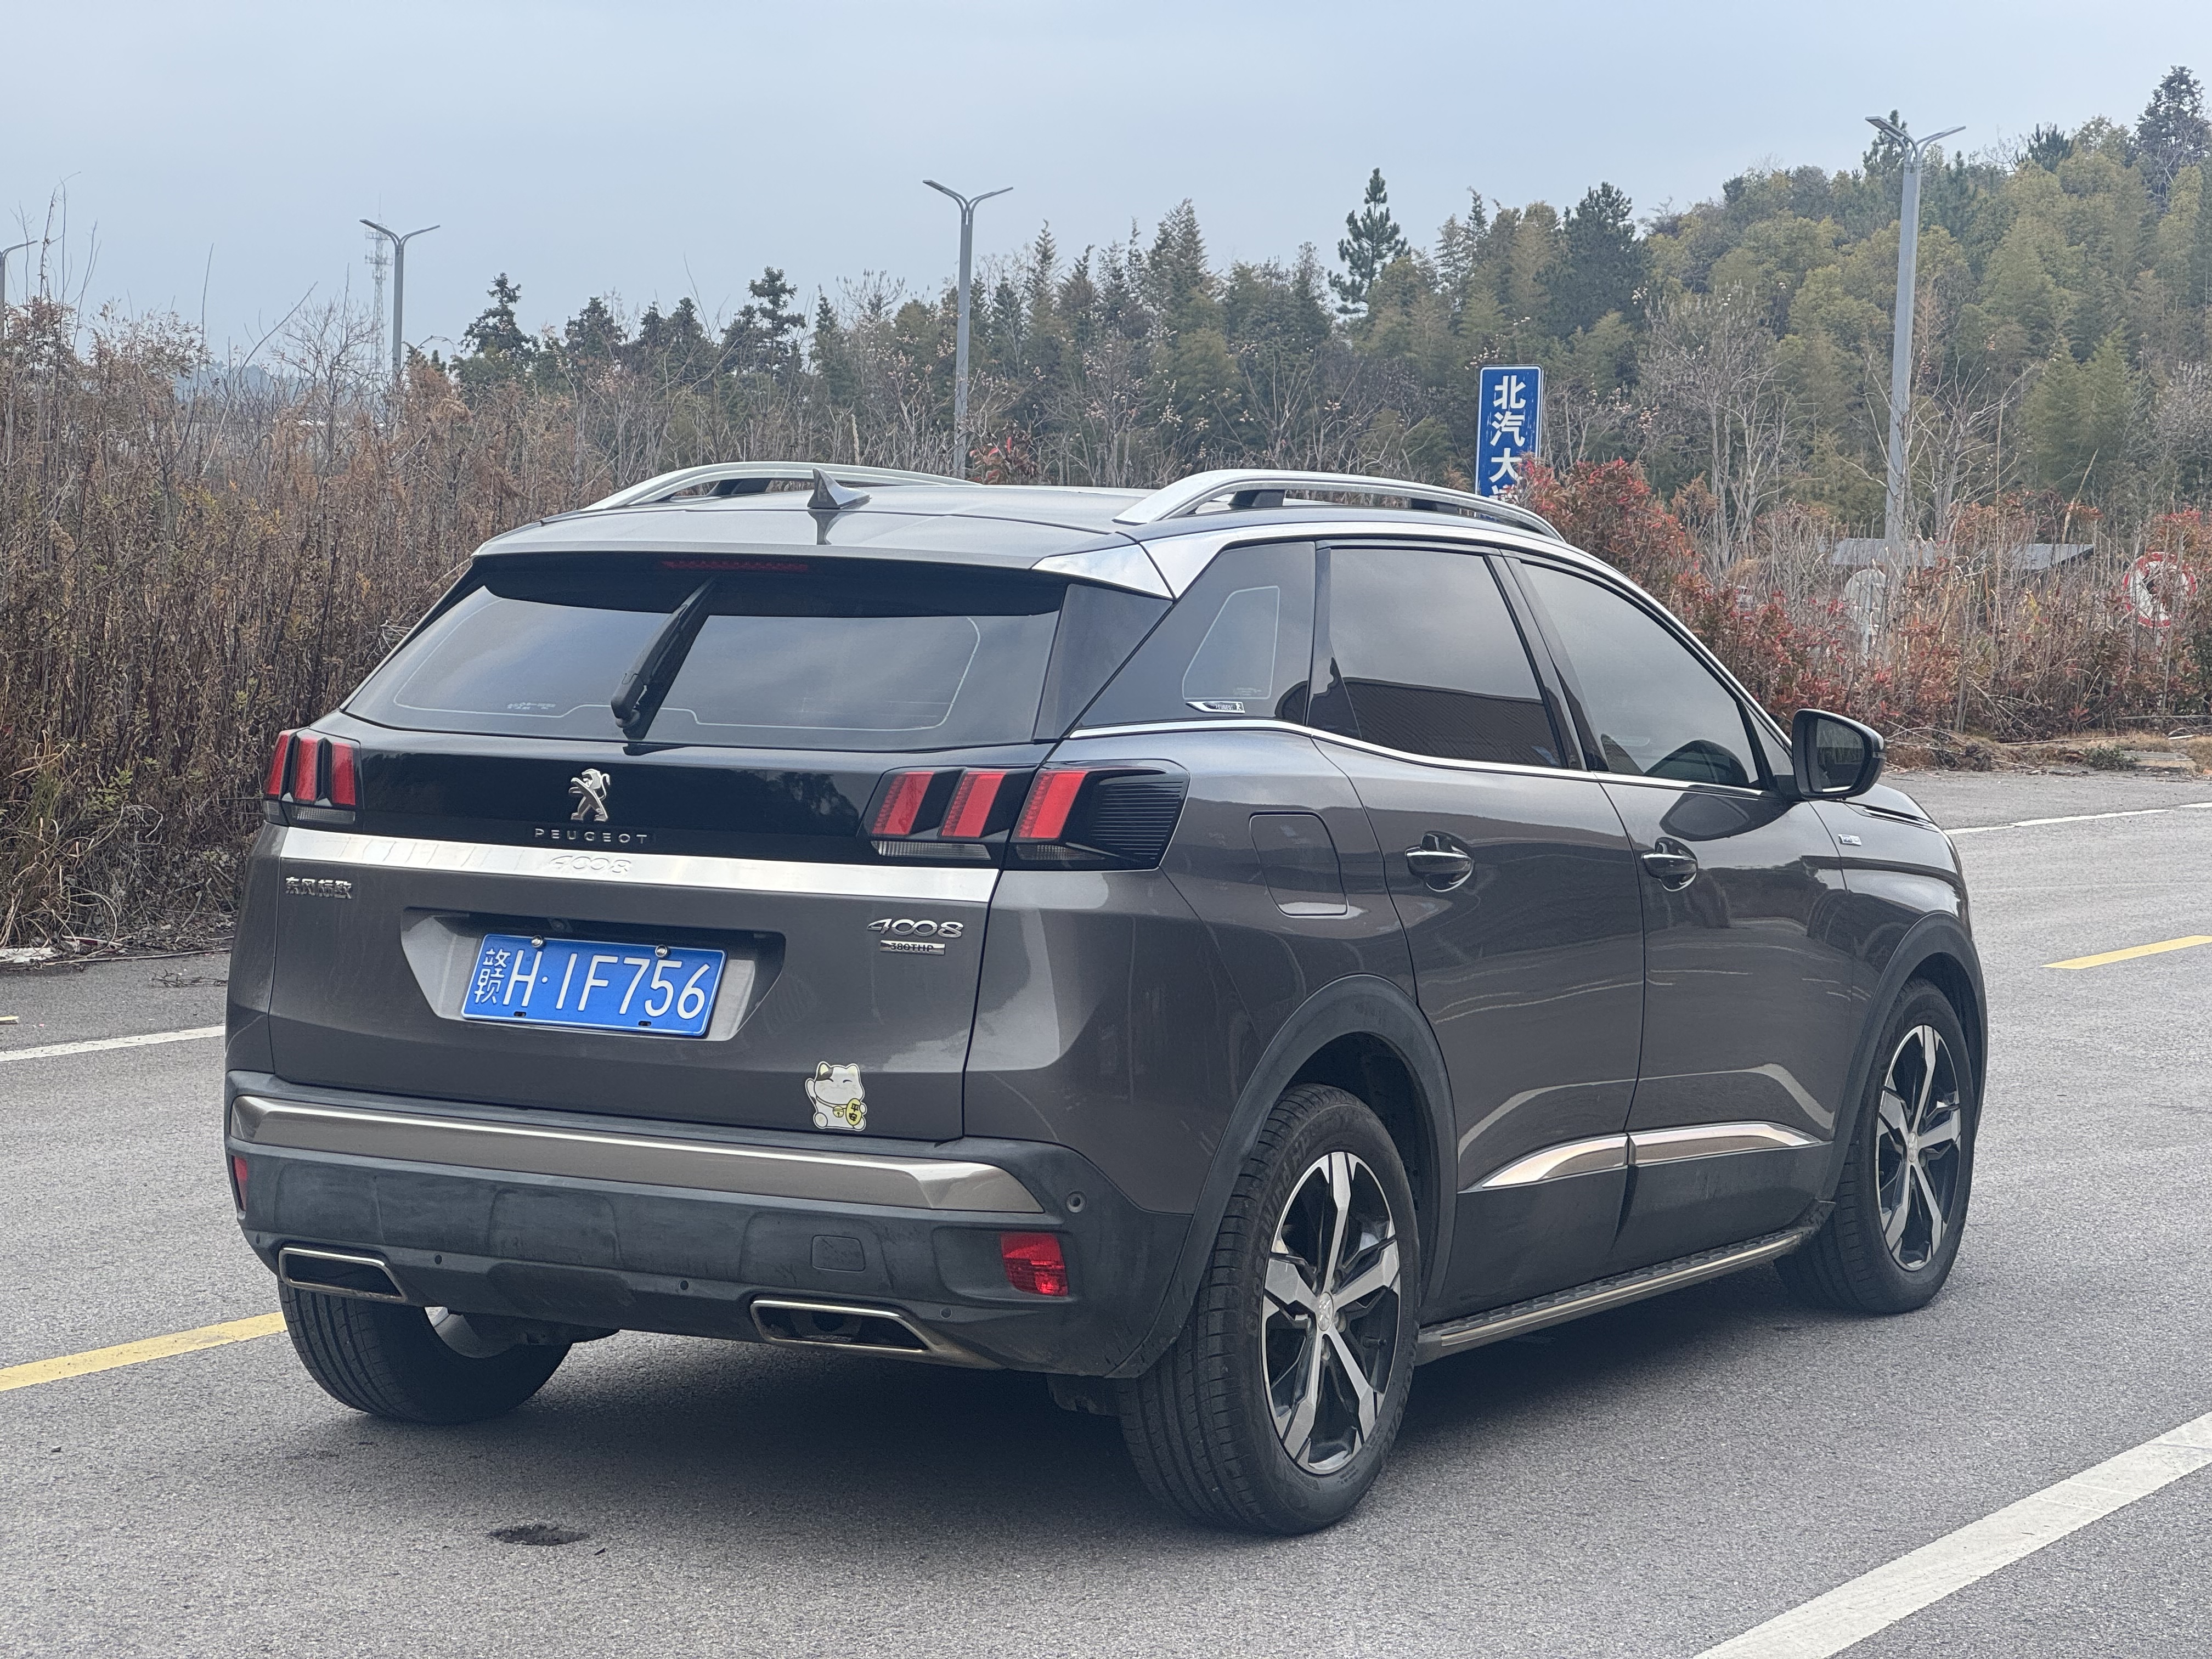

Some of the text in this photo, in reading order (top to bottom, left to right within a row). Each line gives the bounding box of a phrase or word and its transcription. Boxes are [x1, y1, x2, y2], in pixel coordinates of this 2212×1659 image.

[534, 828, 647, 844] PEUGEOT
[549, 855, 632, 873] 4008
[285, 877, 352, 899] 东风标致
[867, 918, 964, 938] 4008
[890, 942, 934, 952] 380THP
[848, 1103, 860, 1122] 平安
